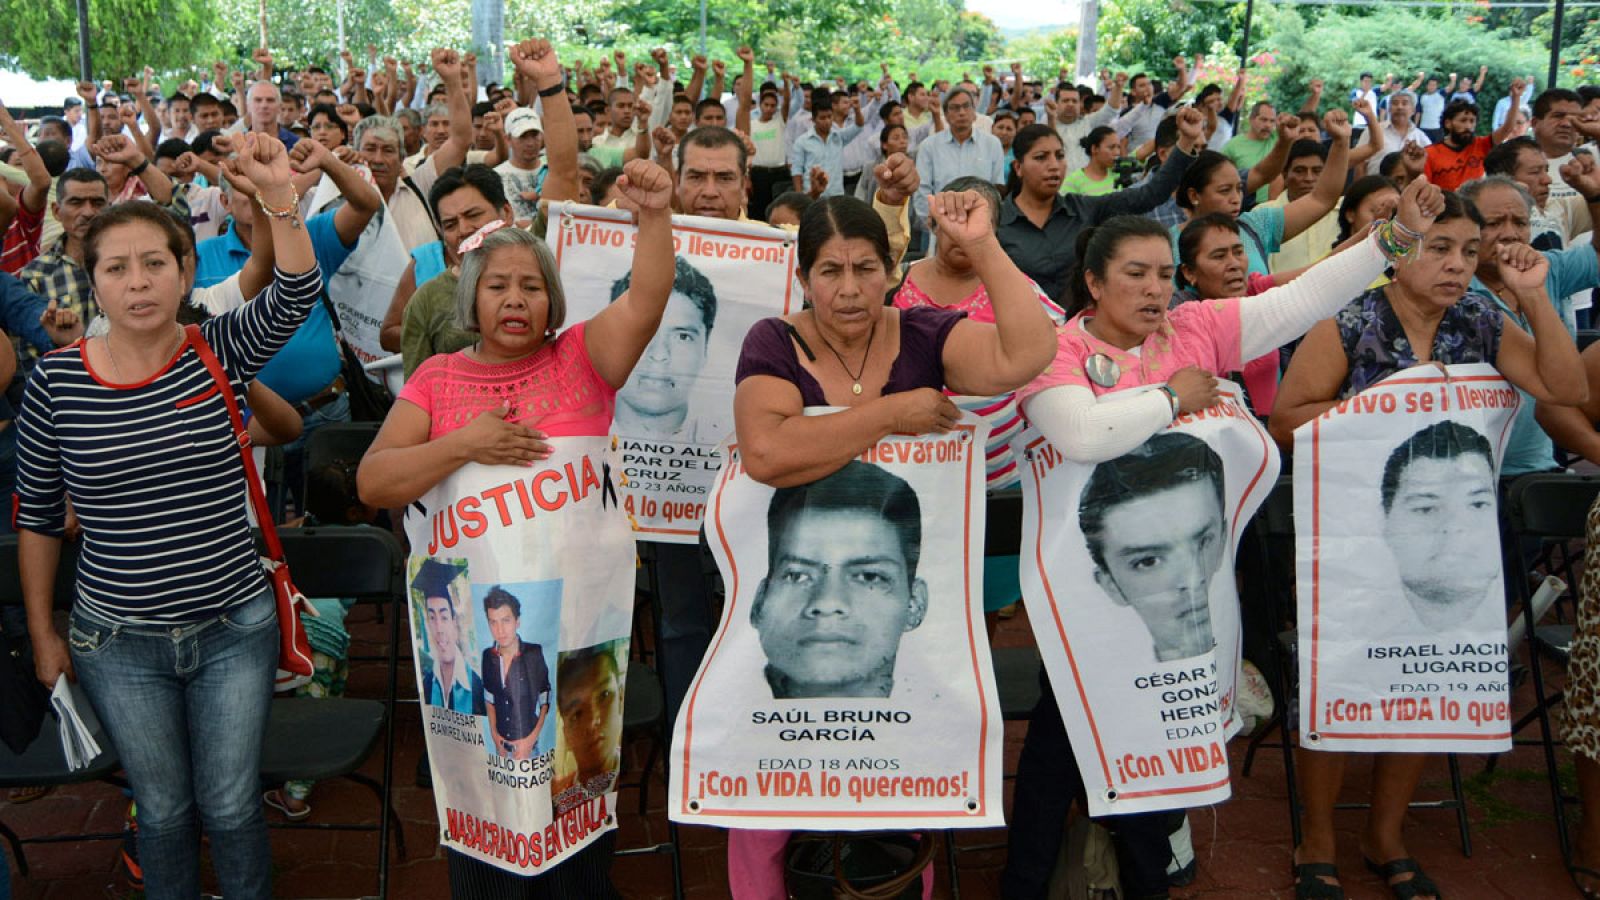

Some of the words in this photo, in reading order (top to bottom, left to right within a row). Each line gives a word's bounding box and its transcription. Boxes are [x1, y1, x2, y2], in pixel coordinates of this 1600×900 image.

[688, 235, 785, 264] llevaron!
[1405, 392, 1434, 413] se
[623, 441, 675, 455] IANO
[623, 455, 662, 467] PAR
[669, 459, 697, 469] DE
[624, 468, 681, 480] CRUZ
[645, 482, 660, 491] 23
[666, 481, 706, 494] AÑOS
[428, 454, 600, 556] JUSTICIA
[641, 495, 657, 517] lo
[662, 501, 707, 523] quer
[1367, 644, 1443, 659] ISRAEL
[1402, 661, 1508, 674] LUGARDO
[1134, 667, 1207, 689] CÉSAR
[1390, 683, 1439, 693] EDAD
[1450, 683, 1468, 692] 19
[752, 708, 816, 724] SAÚL
[823, 711, 911, 723] BRUNO
[1160, 700, 1218, 722] HERN
[1325, 698, 1372, 725] ¡Con
[1381, 697, 1434, 721] VIDA
[1440, 696, 1460, 721] lo
[779, 727, 875, 741] GARCÍA
[1166, 722, 1217, 740] EDAD
[486, 753, 516, 771] JULIO
[519, 748, 555, 773] CESAR
[758, 758, 811, 770] EDAD
[820, 758, 840, 770] 18
[846, 756, 900, 770] AÑOS
[1116, 753, 1165, 784] ¡Con
[1167, 741, 1226, 774] VIDA
[700, 771, 747, 799] ¡Con
[756, 772, 813, 797] VIDA
[821, 771, 841, 797] lo
[848, 771, 969, 803] queremos!
[446, 807, 543, 868] MASACRADOS
[544, 819, 563, 860] EN
[560, 794, 608, 848] IGUALA
